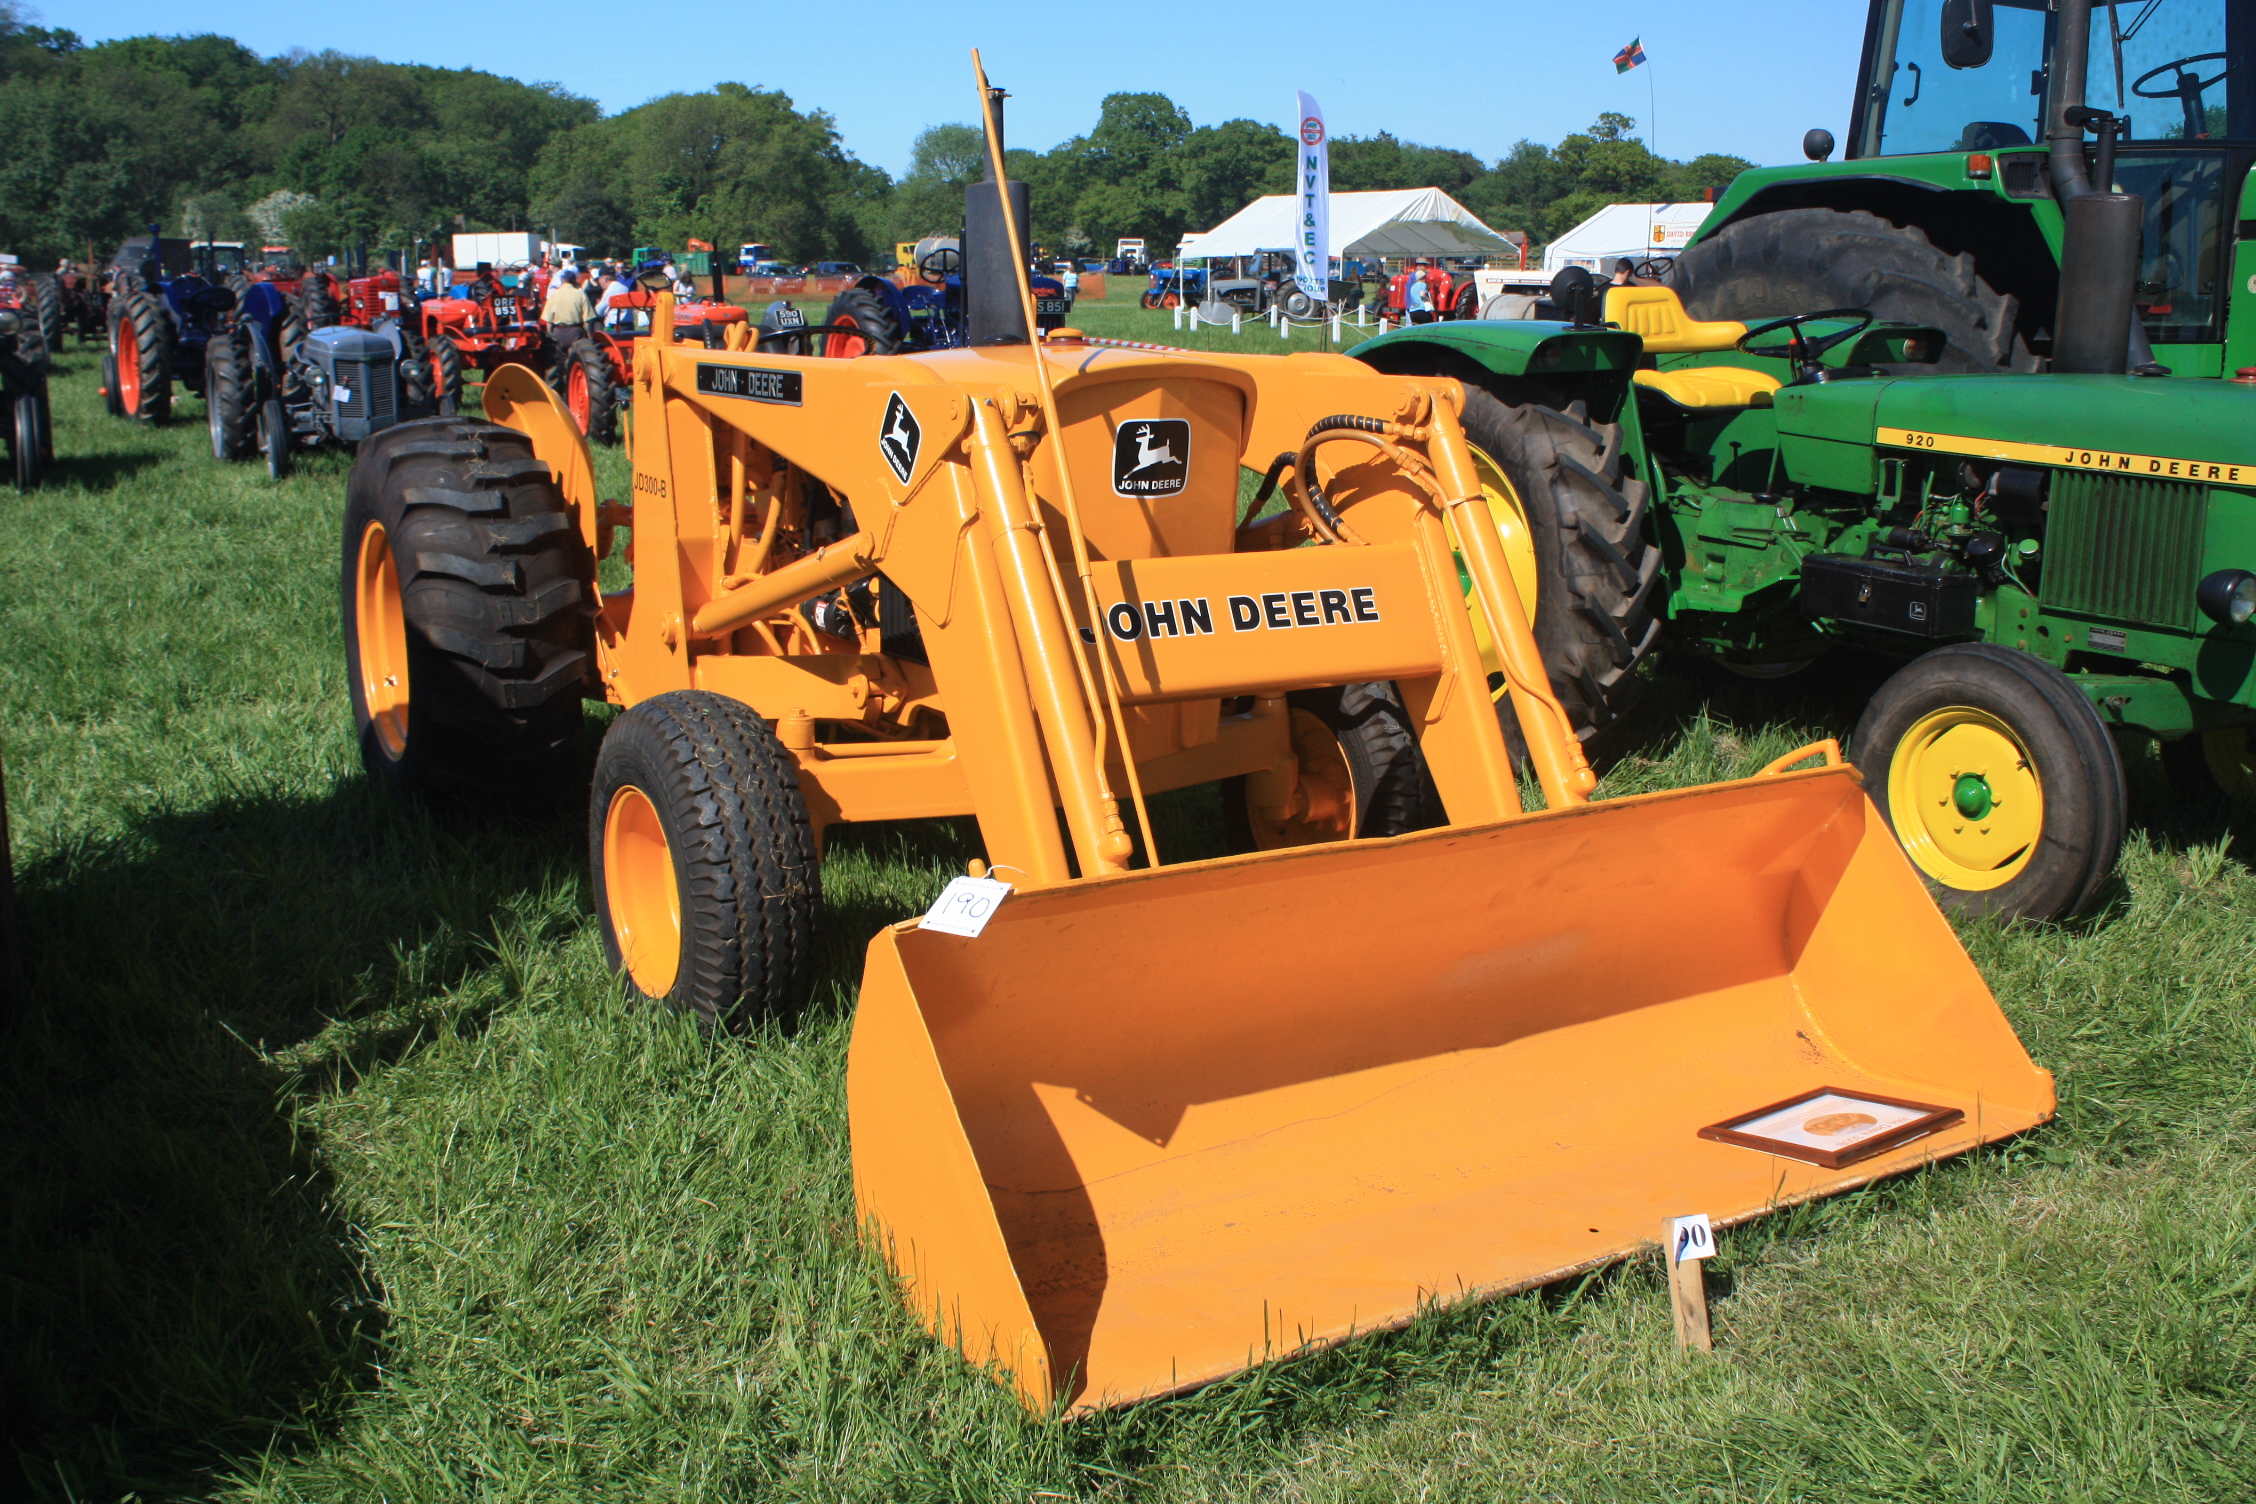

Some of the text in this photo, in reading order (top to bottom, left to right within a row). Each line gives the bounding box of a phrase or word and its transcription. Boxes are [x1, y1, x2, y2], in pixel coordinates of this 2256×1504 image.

[494, 306, 517, 316] 853
[780, 310, 798, 318] 590
[781, 317, 800, 325] UXN
[711, 368, 784, 399] JOHN DEERE
[880, 437, 908, 481] JOHN DEERE
[1905, 433, 2241, 481] 920 JOHN DEERE
[633, 472, 667, 498] JD300-B
[1118, 479, 1182, 490] JOHN DEERE
[1227, 587, 1380, 632] DEERE
[942, 892, 990, 918] 190
